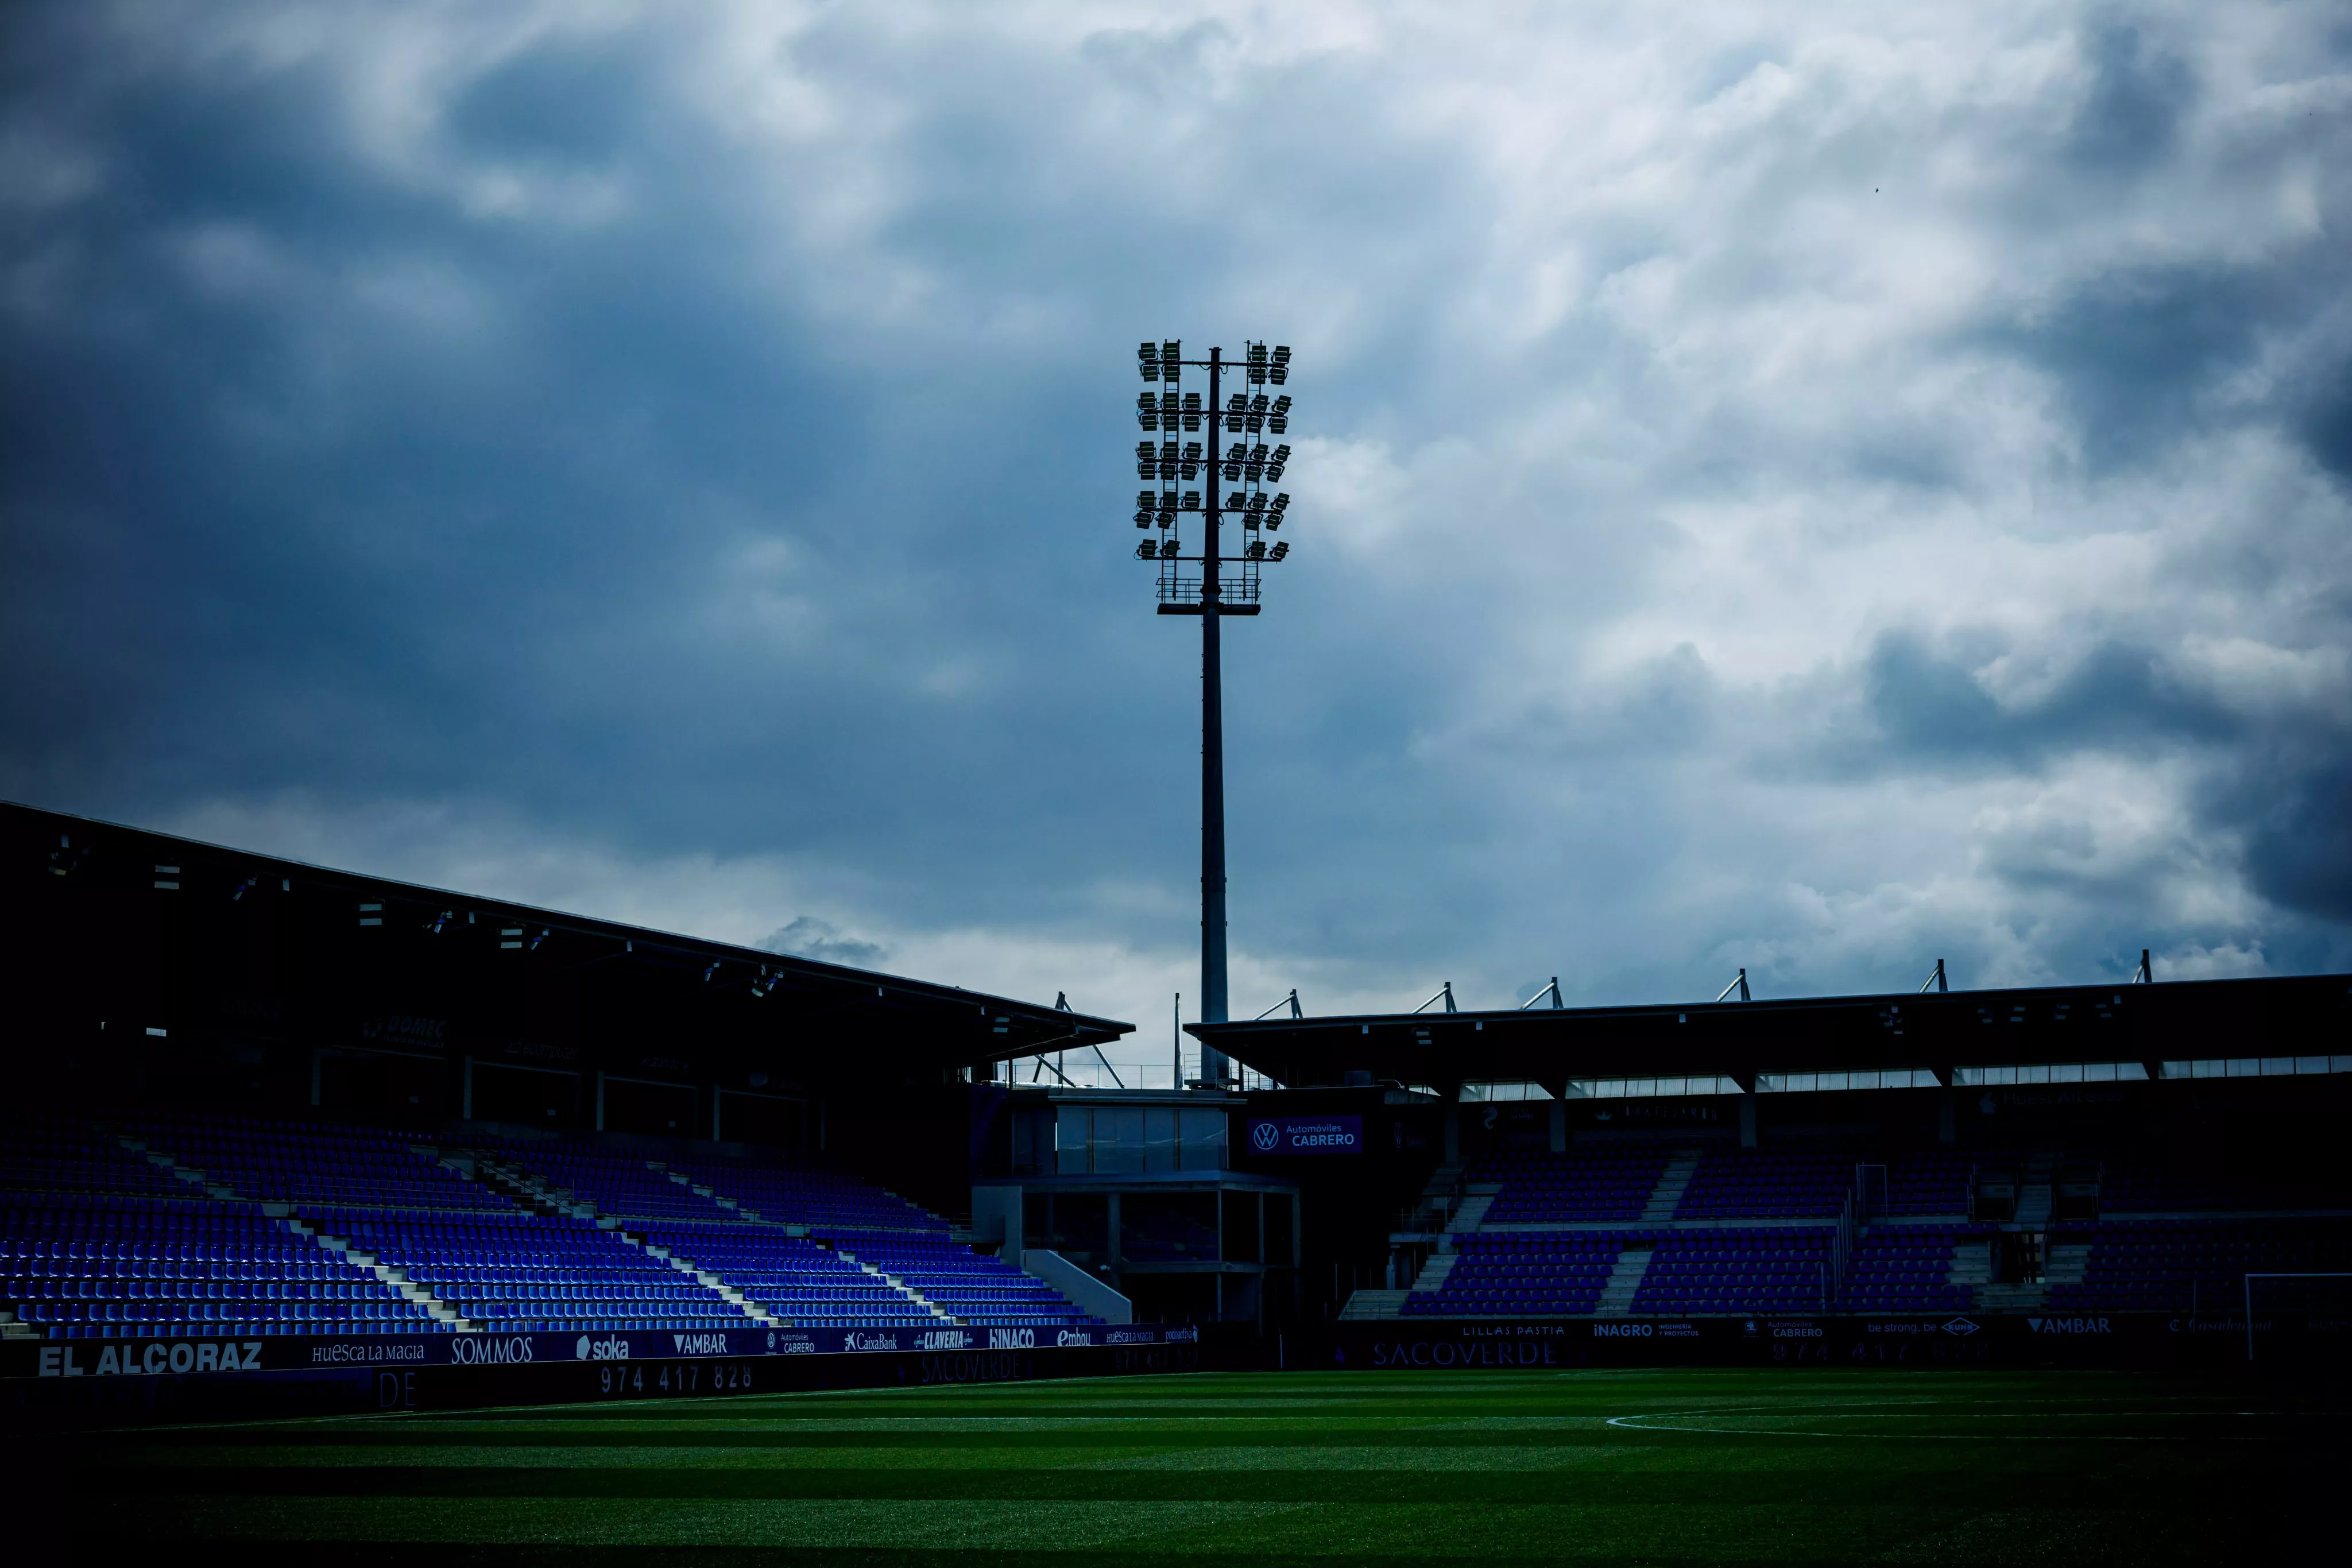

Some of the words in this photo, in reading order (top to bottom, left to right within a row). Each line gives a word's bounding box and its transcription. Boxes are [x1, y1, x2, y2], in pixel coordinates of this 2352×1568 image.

[1286, 1124, 1341, 1134] Automóviles
[1292, 1133, 1355, 1147] CABRERO
[1463, 1326, 1510, 1335] LILLAS
[1517, 1326, 1565, 1335] PASTIA
[1773, 1328, 1823, 1338] CABRERO
[1868, 1323, 1881, 1332] be
[1924, 1322, 1937, 1331] be
[2043, 1318, 2112, 1334] AMBAR
[683, 1333, 728, 1354] AMBAR
[781, 1333, 808, 1341] Automóviles
[857, 1333, 897, 1350] CaixaBank
[924, 1331, 964, 1349] CLAVERIA
[1057, 1327, 1090, 1346] embou
[1165, 1327, 1192, 1343] podoactiva
[451, 1337, 533, 1365] SOMMOS
[593, 1334, 629, 1360] soka
[784, 1342, 815, 1353] CABRERO
[1373, 1341, 1558, 1366] SACOVERDE
[38, 1346, 84, 1376] EL
[95, 1342, 262, 1375] ALCORAZ
[922, 1352, 1020, 1383] SACOVERDE
[380, 1371, 416, 1408] DE
